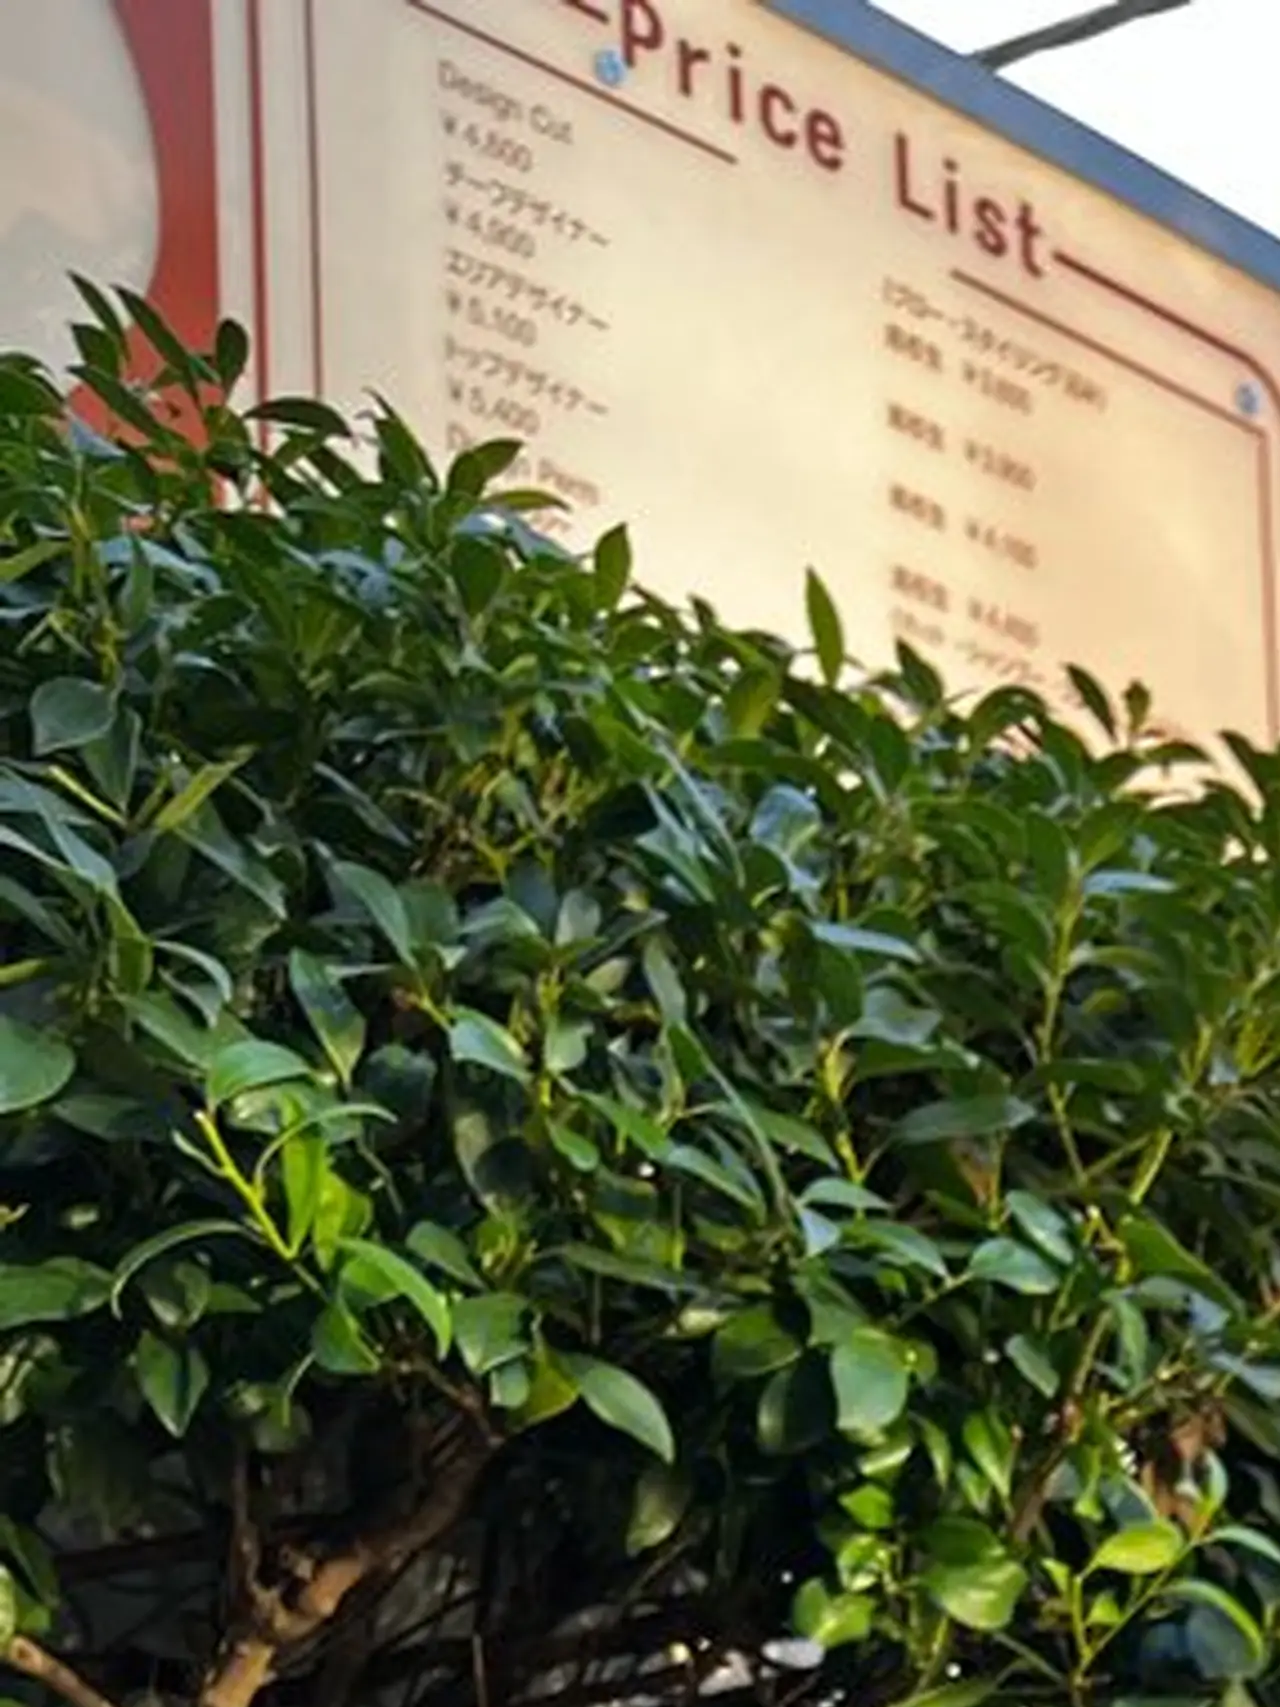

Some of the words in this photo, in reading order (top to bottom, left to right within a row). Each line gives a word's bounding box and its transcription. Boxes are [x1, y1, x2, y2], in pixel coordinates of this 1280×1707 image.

[437, 59, 523, 121] Design
[529, 102, 574, 145] Cut
[620, 0, 843, 171] Price
[894, 131, 1042, 279] List
